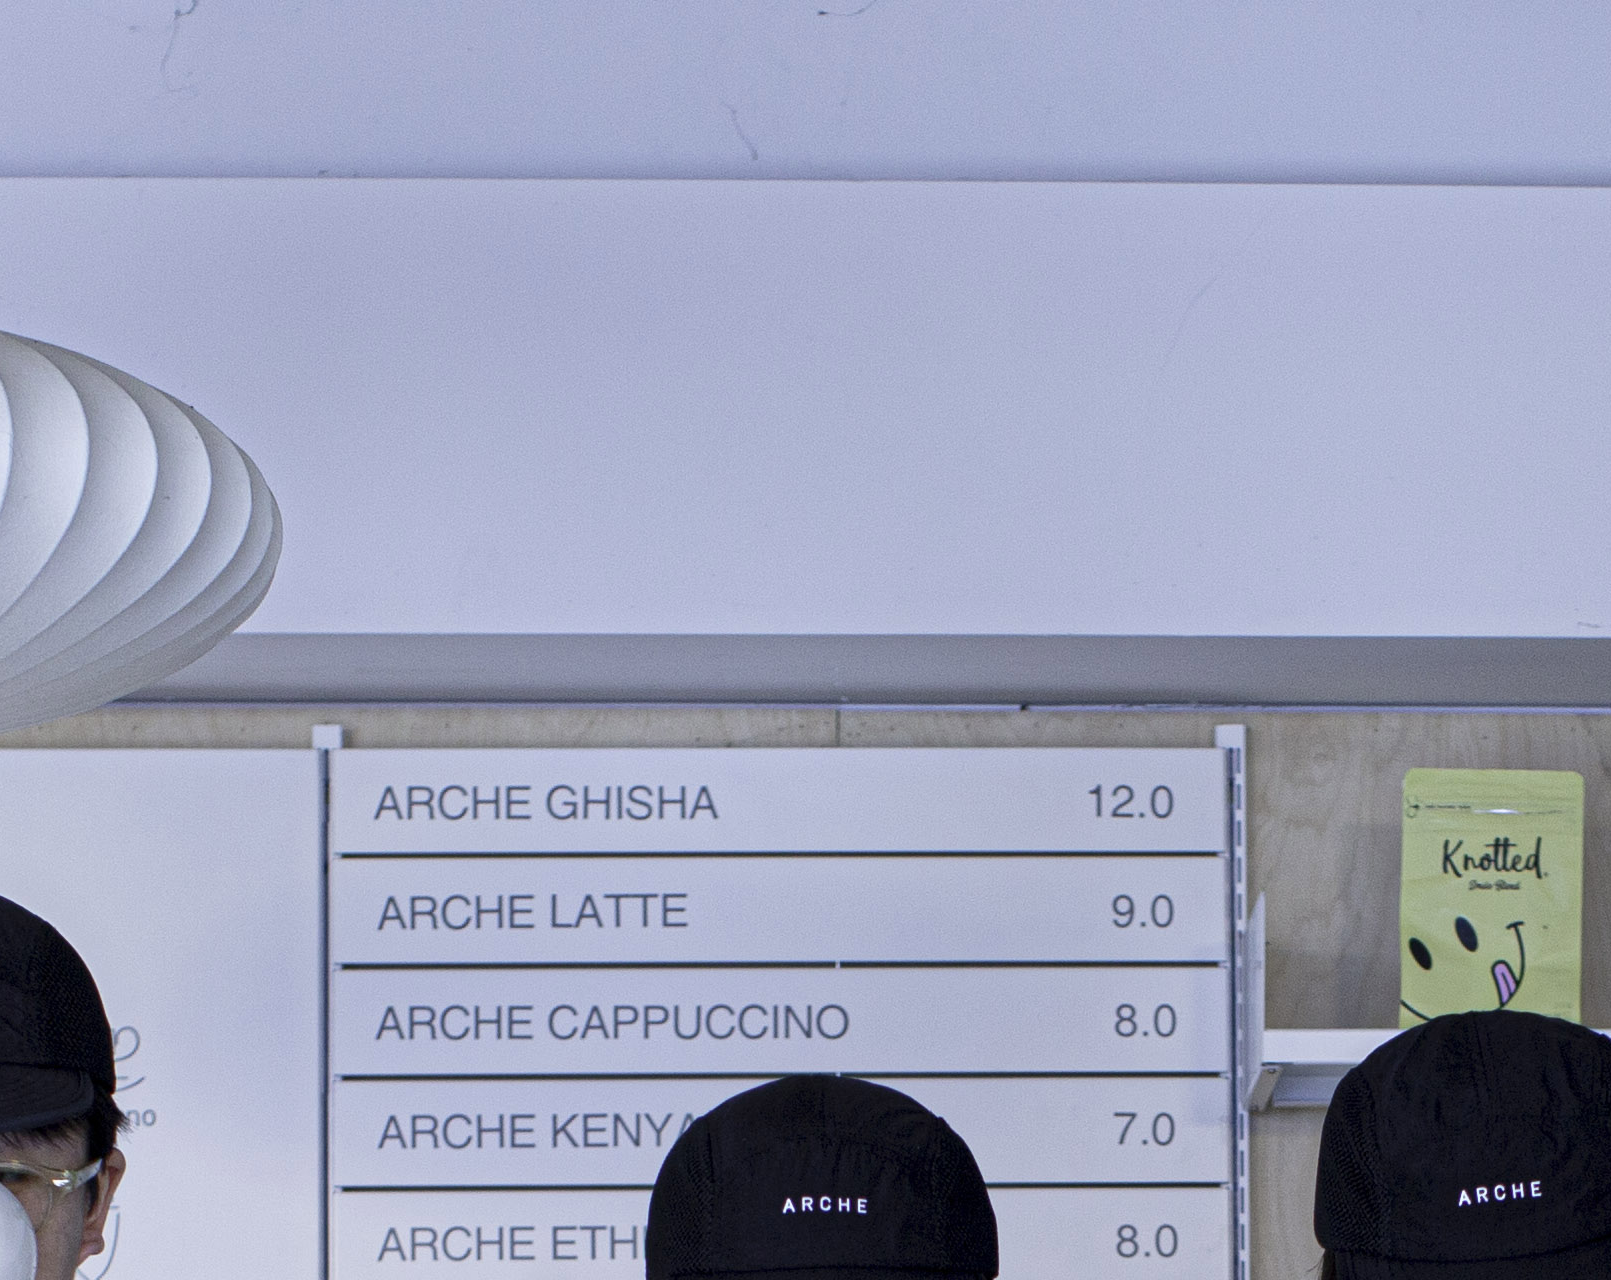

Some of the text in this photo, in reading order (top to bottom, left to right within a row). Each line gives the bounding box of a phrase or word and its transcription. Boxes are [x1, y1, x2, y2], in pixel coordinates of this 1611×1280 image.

[373, 783, 720, 821] ARCHE GHISHA
[1088, 783, 1175, 820] 12.0
[376, 892, 689, 931] ARCHE LATTE
[1111, 893, 1175, 929] 9.0
[375, 1003, 850, 1041] ARCHE CAPPUCCINO
[1114, 1003, 1178, 1039] 8.0
[377, 1113, 537, 1150] ARCHE
[1113, 1111, 1176, 1147] 7.0
[782, 1195, 868, 1214] ARCHE
[1458, 1180, 1542, 1207] ARCHE
[377, 1225, 536, 1263] ARCHE
[1115, 1223, 1179, 1259] 8.0
